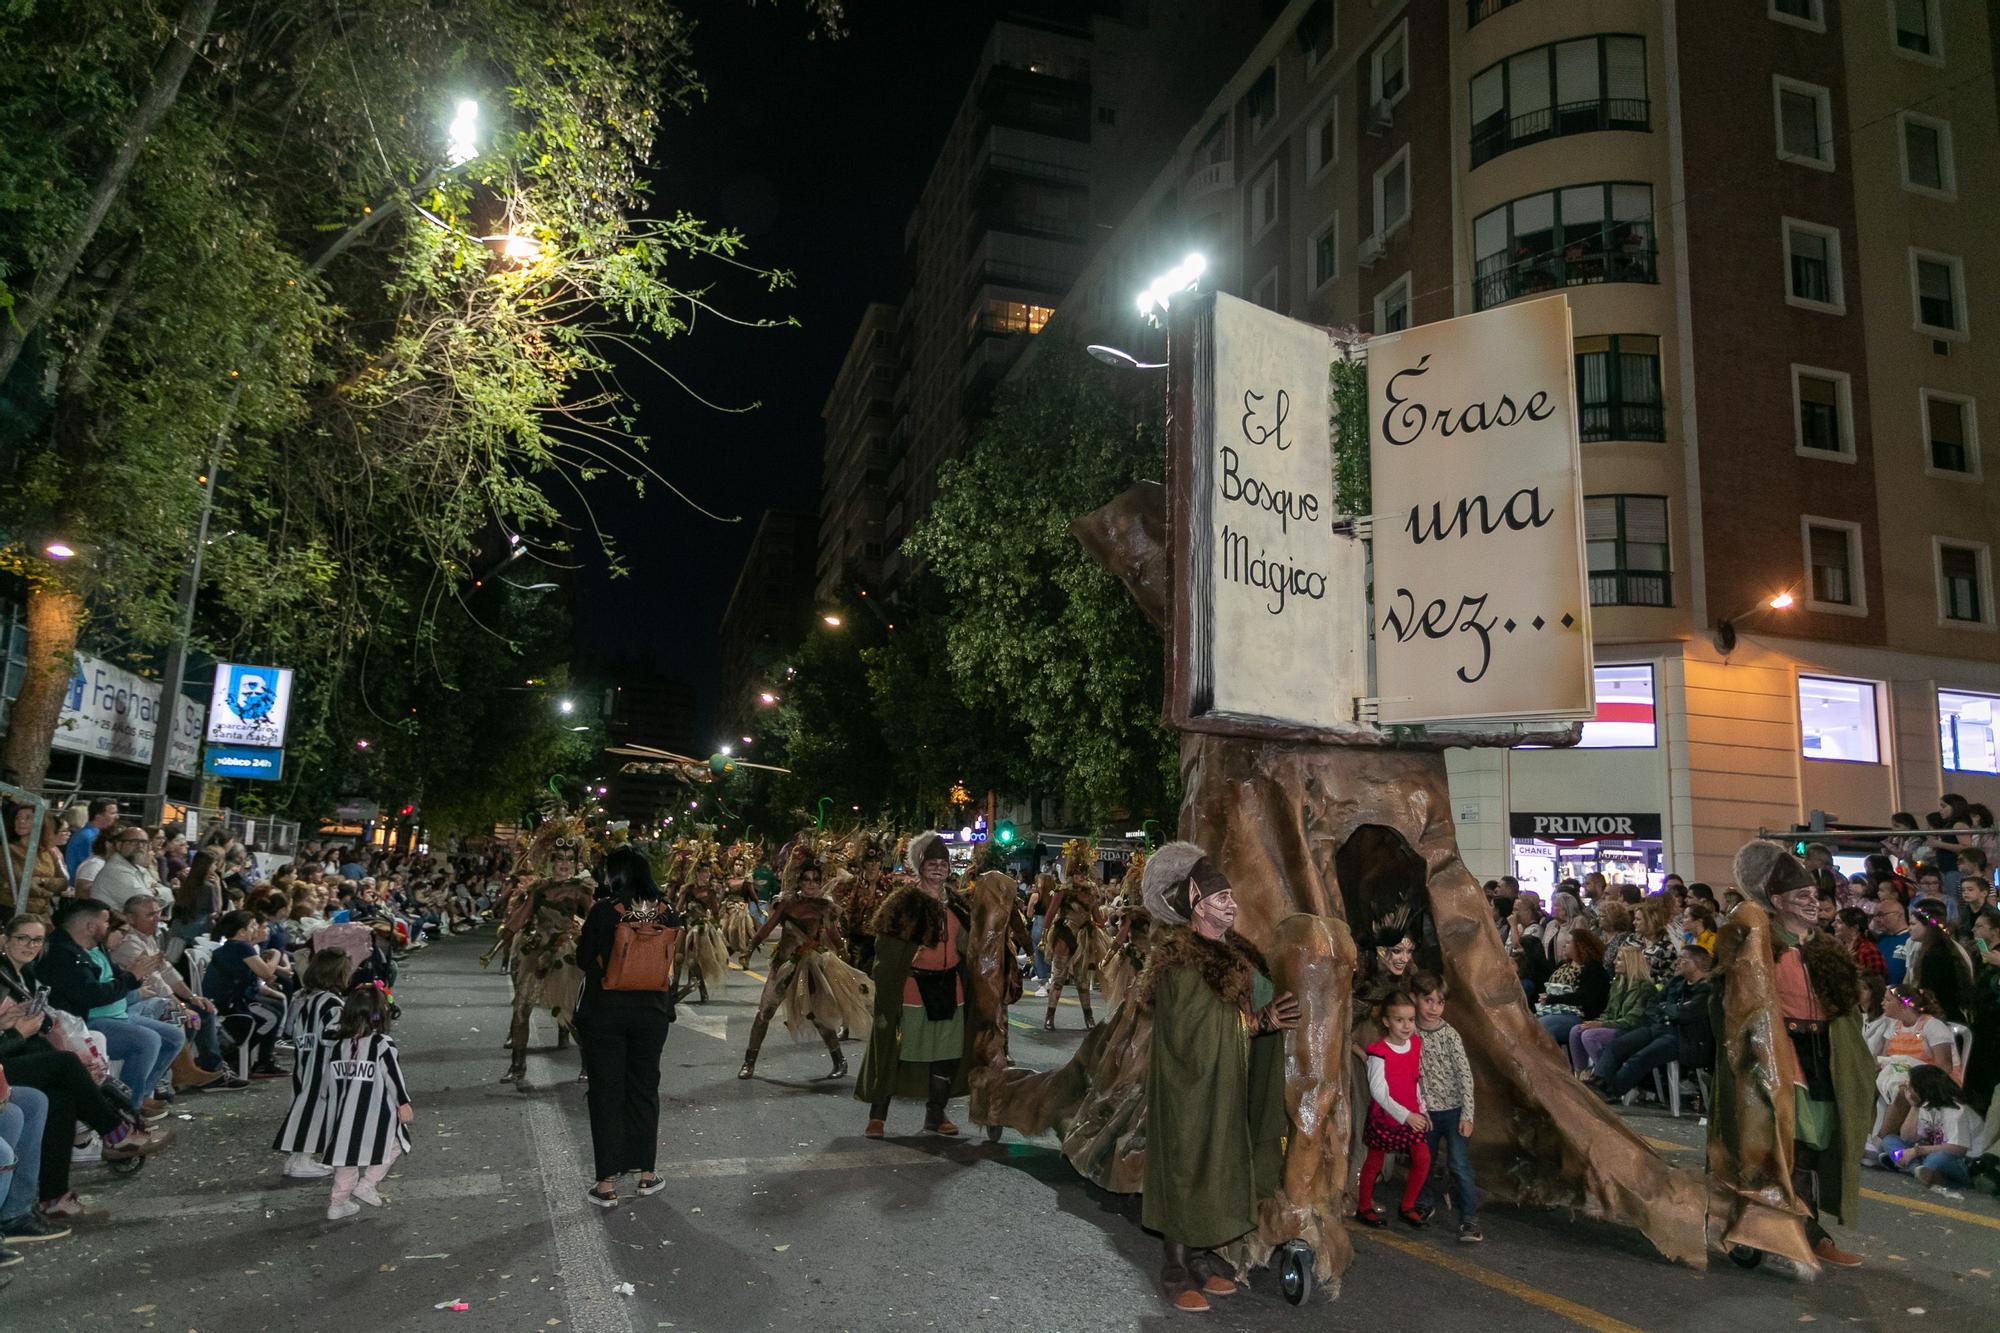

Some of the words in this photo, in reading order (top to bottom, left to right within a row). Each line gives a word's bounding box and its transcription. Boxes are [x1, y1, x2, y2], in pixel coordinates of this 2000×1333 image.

[1242, 389, 1292, 451] El
[1381, 353, 1556, 446] Érase
[1220, 446, 1319, 534] Bosque
[1405, 486, 1554, 545] una
[1221, 525, 1326, 614] Mágico
[1519, 846, 1553, 856] CHANEL
[1533, 816, 1635, 835] PRIMOR
